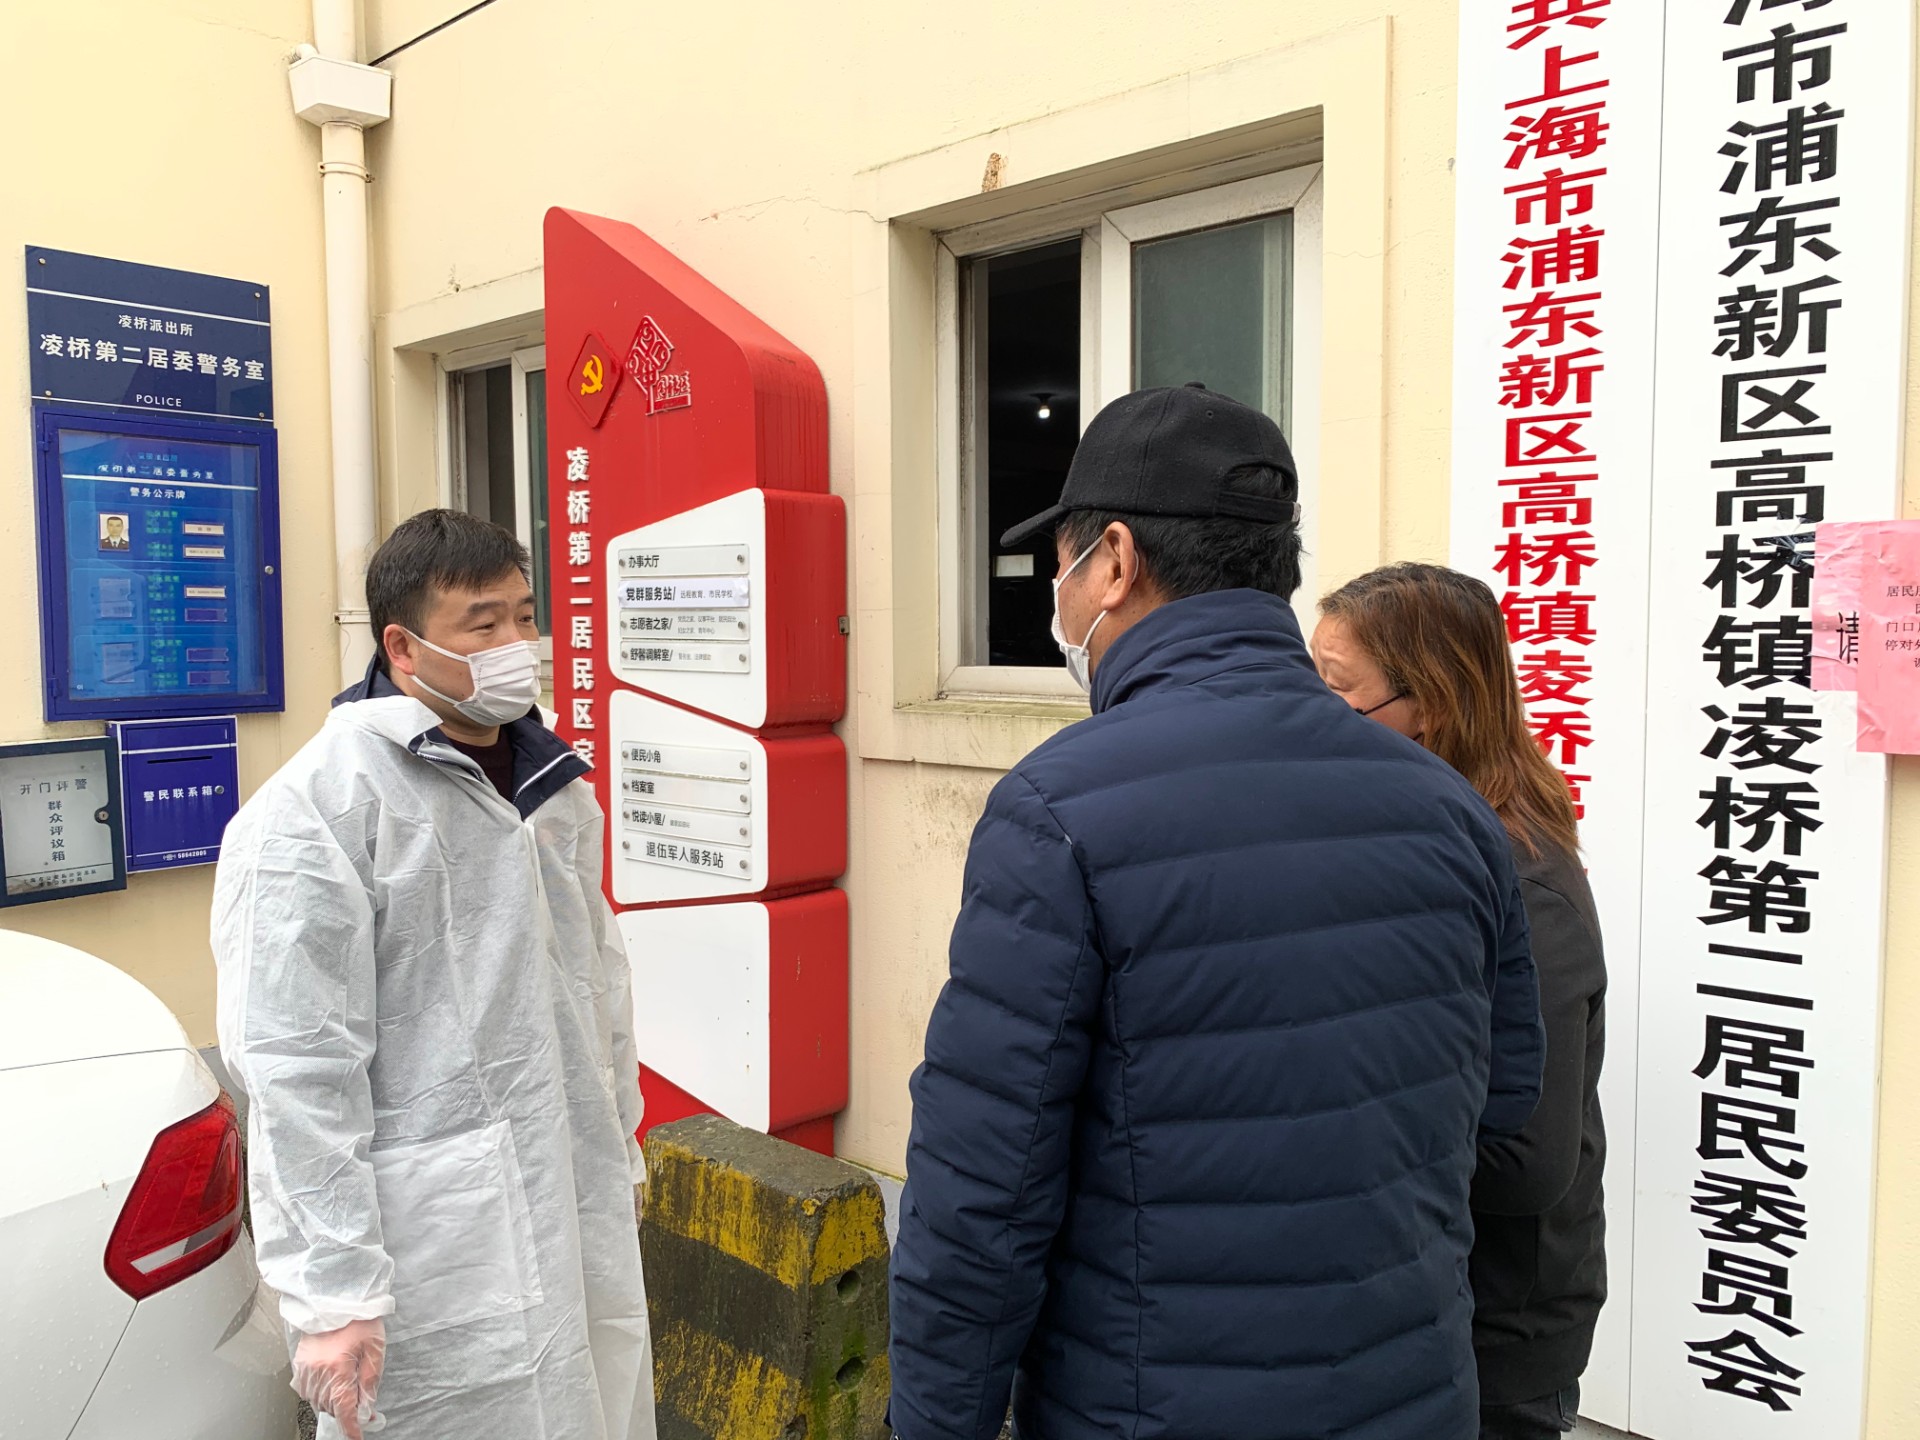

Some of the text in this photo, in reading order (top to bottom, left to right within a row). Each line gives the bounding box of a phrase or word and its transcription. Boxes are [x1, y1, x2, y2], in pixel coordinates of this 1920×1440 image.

[118, 314, 193, 337] 凌桥派出所
[40, 333, 265, 381] 凌桥第二居委警务室
[136, 394, 182, 407] POLICE
[130, 486, 186, 499] 警务公示牌
[628, 555, 660, 568] 办事大厅
[1886, 621, 1920, 632] 门口
[1683, 0, 1848, 1412] 市浦东新区高桥镇凌桥第二居民委员会
[631, 748, 661, 763] 便民小角
[20, 778, 88, 795] 开门评警
[143, 785, 213, 801] 警民联系箱
[631, 780, 655, 794] 档案室
[48, 800, 66, 862] 群众评议箱
[646, 841, 724, 869] 退伍军人服务站
